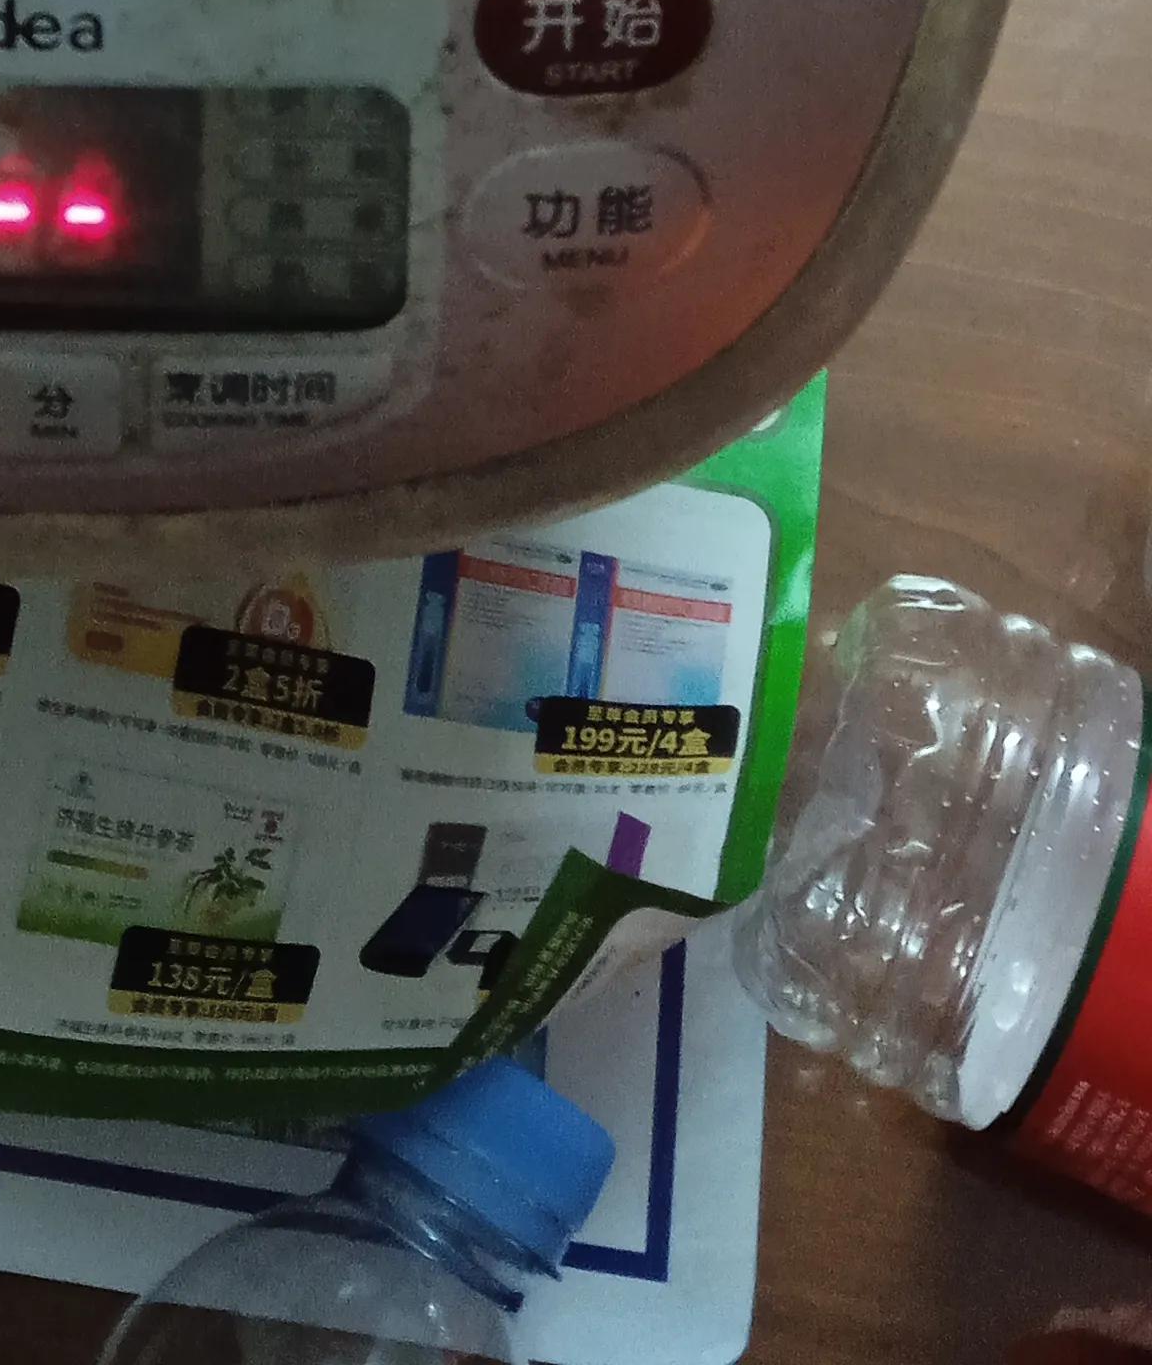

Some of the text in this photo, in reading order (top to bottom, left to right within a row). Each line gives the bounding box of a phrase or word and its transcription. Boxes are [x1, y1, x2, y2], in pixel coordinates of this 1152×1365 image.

[544, 57, 639, 86] START
[520, 184, 653, 239] 功能
[30, 382, 77, 420] 分
[561, 725, 712, 757] 199元/4盒
[147, 961, 278, 1000] 138元/盒
